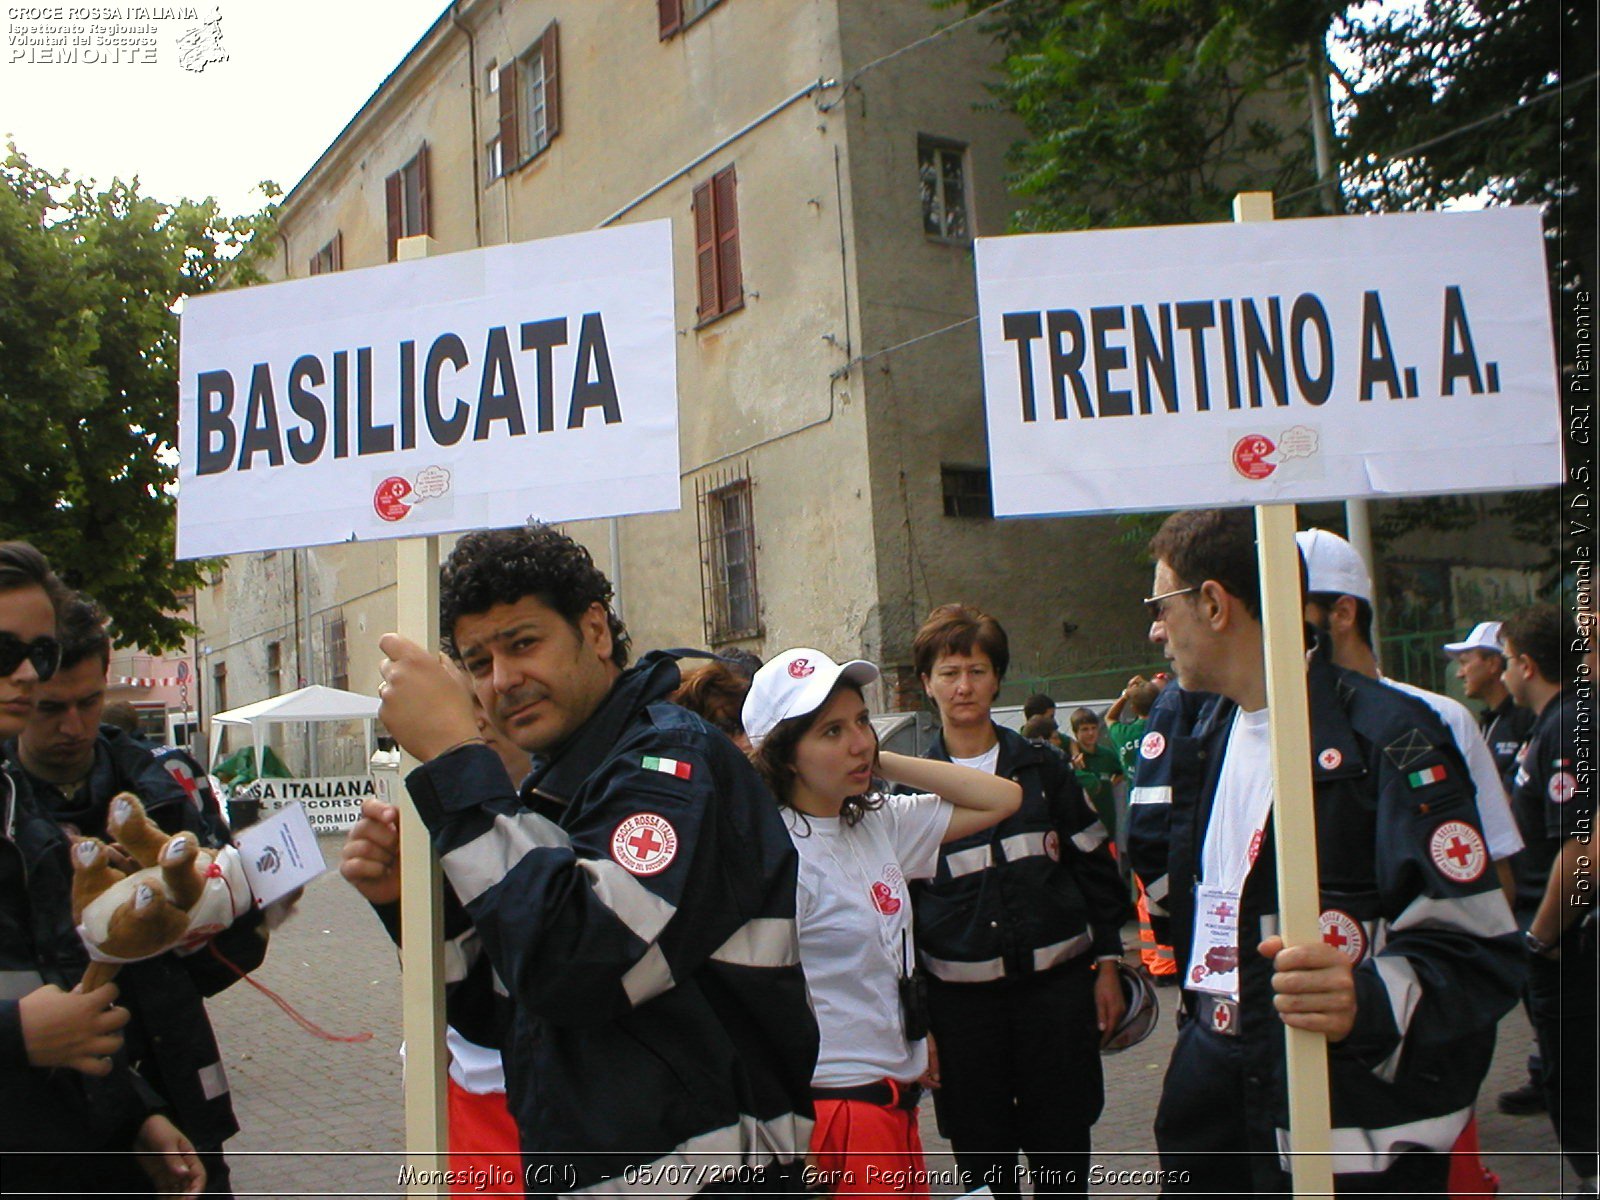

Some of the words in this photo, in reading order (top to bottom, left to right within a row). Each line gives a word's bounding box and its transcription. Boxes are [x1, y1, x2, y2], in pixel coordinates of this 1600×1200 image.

[1002, 292, 1335, 423] TRENTINO
[1359, 290, 1419, 401] A.
[1440, 285, 1501, 396] A.
[195, 311, 623, 476] BASILICATA
[273, 798, 364, 810] SCORSO
[282, 780, 376, 798] ITALIANA
[615, 820, 635, 844] CROCE
[633, 815, 660, 828] ROSSA
[658, 822, 676, 855] ITALIANA
